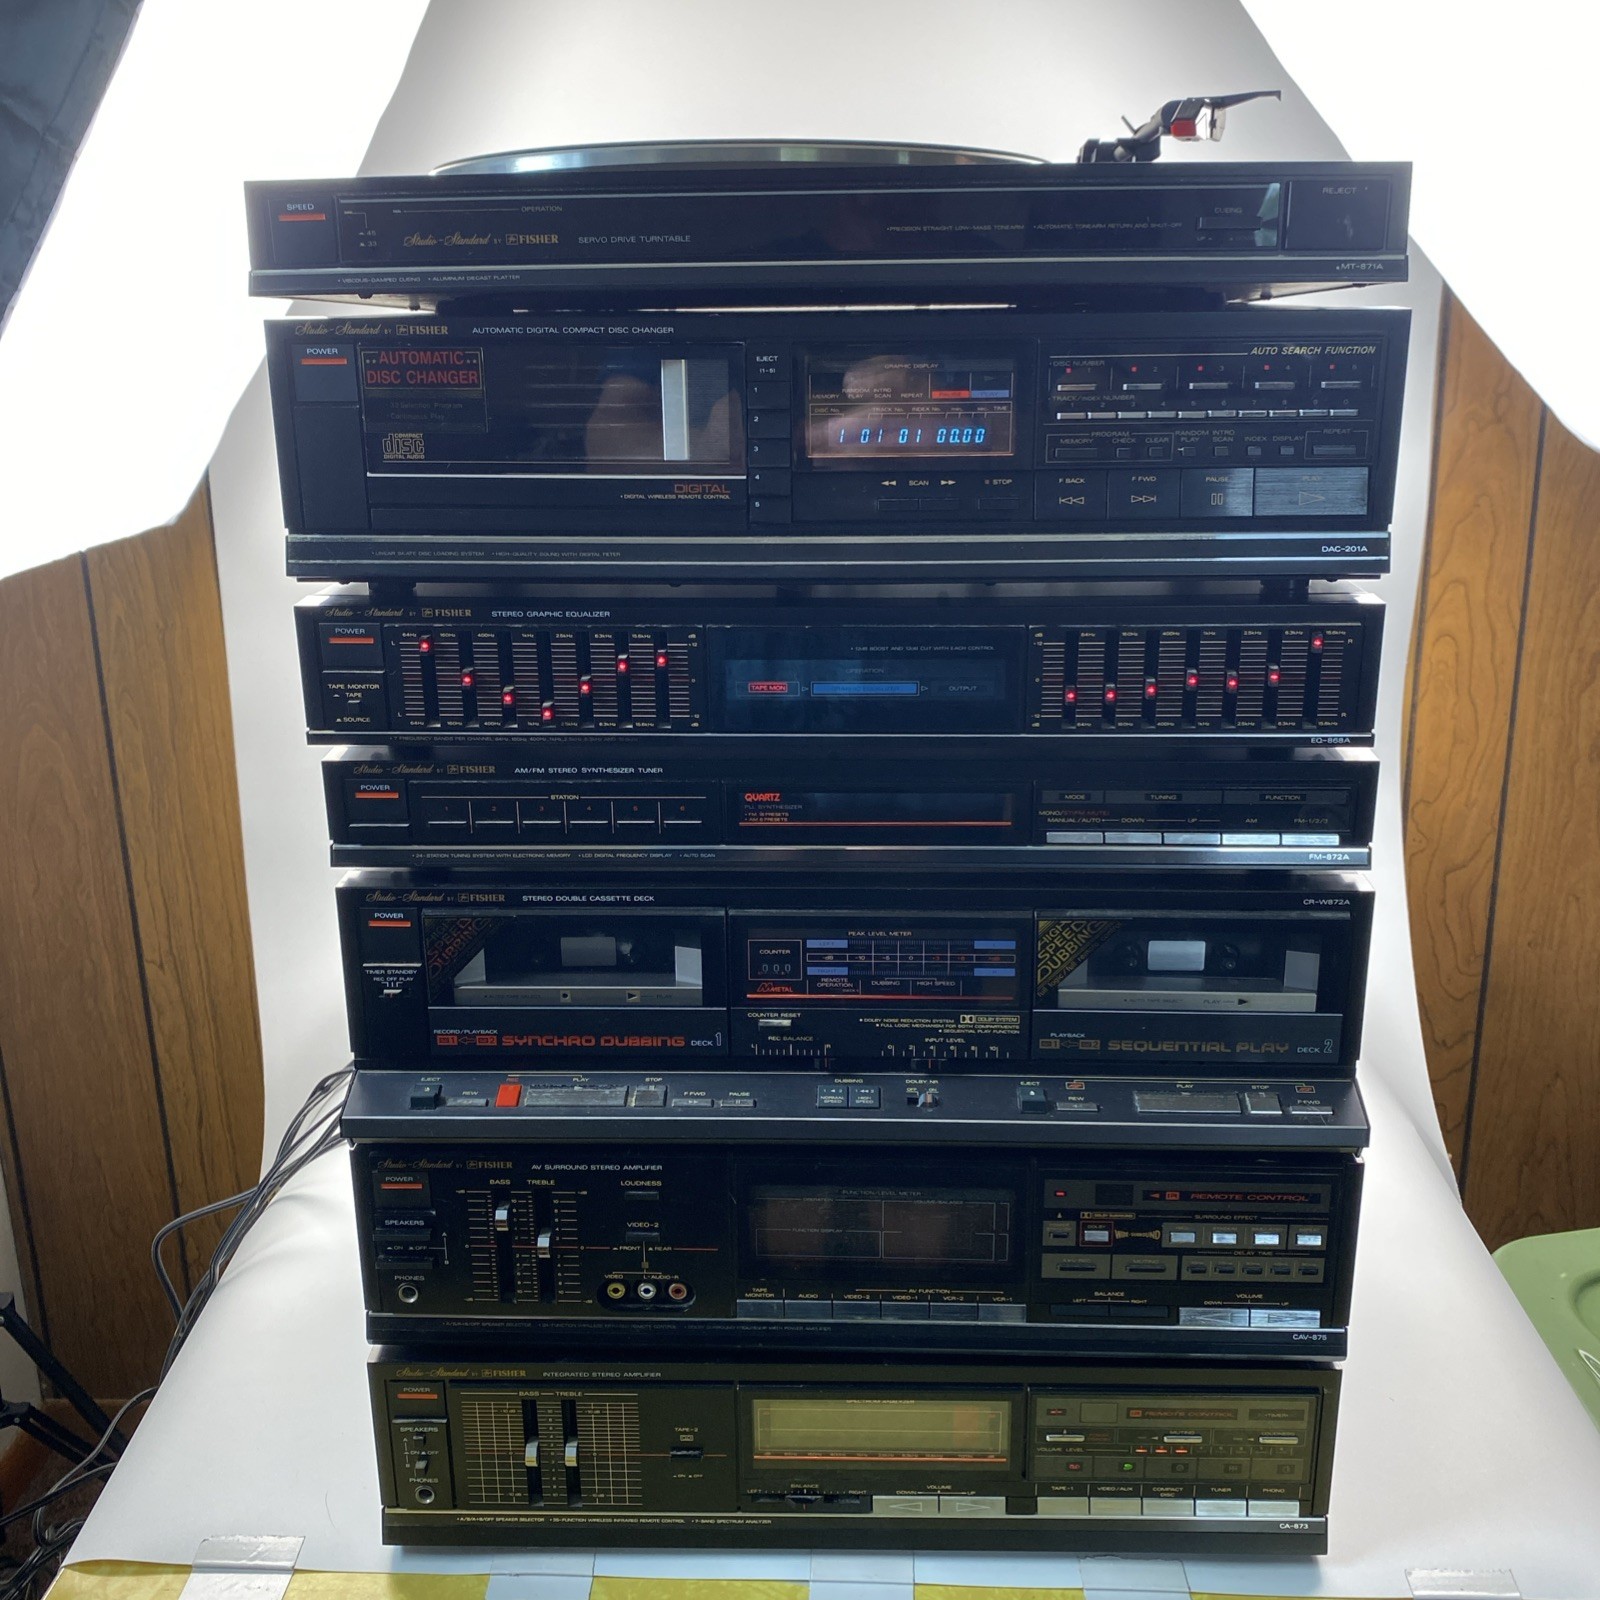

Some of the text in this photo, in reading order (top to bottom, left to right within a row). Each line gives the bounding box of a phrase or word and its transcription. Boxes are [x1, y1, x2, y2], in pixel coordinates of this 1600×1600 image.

[286, 203, 314, 211] SPEED
[519, 234, 558, 244] FISHER
[578, 234, 691, 244] SERVO DRIVE TURNTABLE
[409, 326, 448, 335] FISHER
[632, 326, 674, 334] CHANGER
[1250, 346, 1376, 355] AUTO SEARCH FUNCTION
[379, 351, 464, 365] AUTOMATIC
[366, 370, 479, 384] DISC CHANGER
[839, 429, 845, 443] 1
[860, 429, 883, 444] 01
[898, 429, 922, 444] 01
[674, 484, 731, 494] DIGITAL
[1321, 545, 1368, 553] DAC-201A
[435, 608, 472, 617] FISHER
[565, 610, 611, 618] EQUALIZER
[459, 765, 496, 774] FISHER
[744, 792, 781, 802] QUARTZ
[470, 894, 505, 902] FISHER
[1038, 920, 1072, 951] HIGH
[1037, 920, 1087, 967] SPEED
[1037, 920, 1108, 985] DUBBING
[502, 1035, 596, 1047] SYNCHRO
[600, 1036, 686, 1047] DUBBING
[715, 1032, 722, 1047] 1
[1108, 1040, 1232, 1052] SEQUENTIAL
[1235, 1042, 1289, 1053] PLAY
[1324, 1039, 1333, 1053] 2
[478, 1161, 513, 1170] FISHER
[1246, 1194, 1309, 1202] CONTROL
